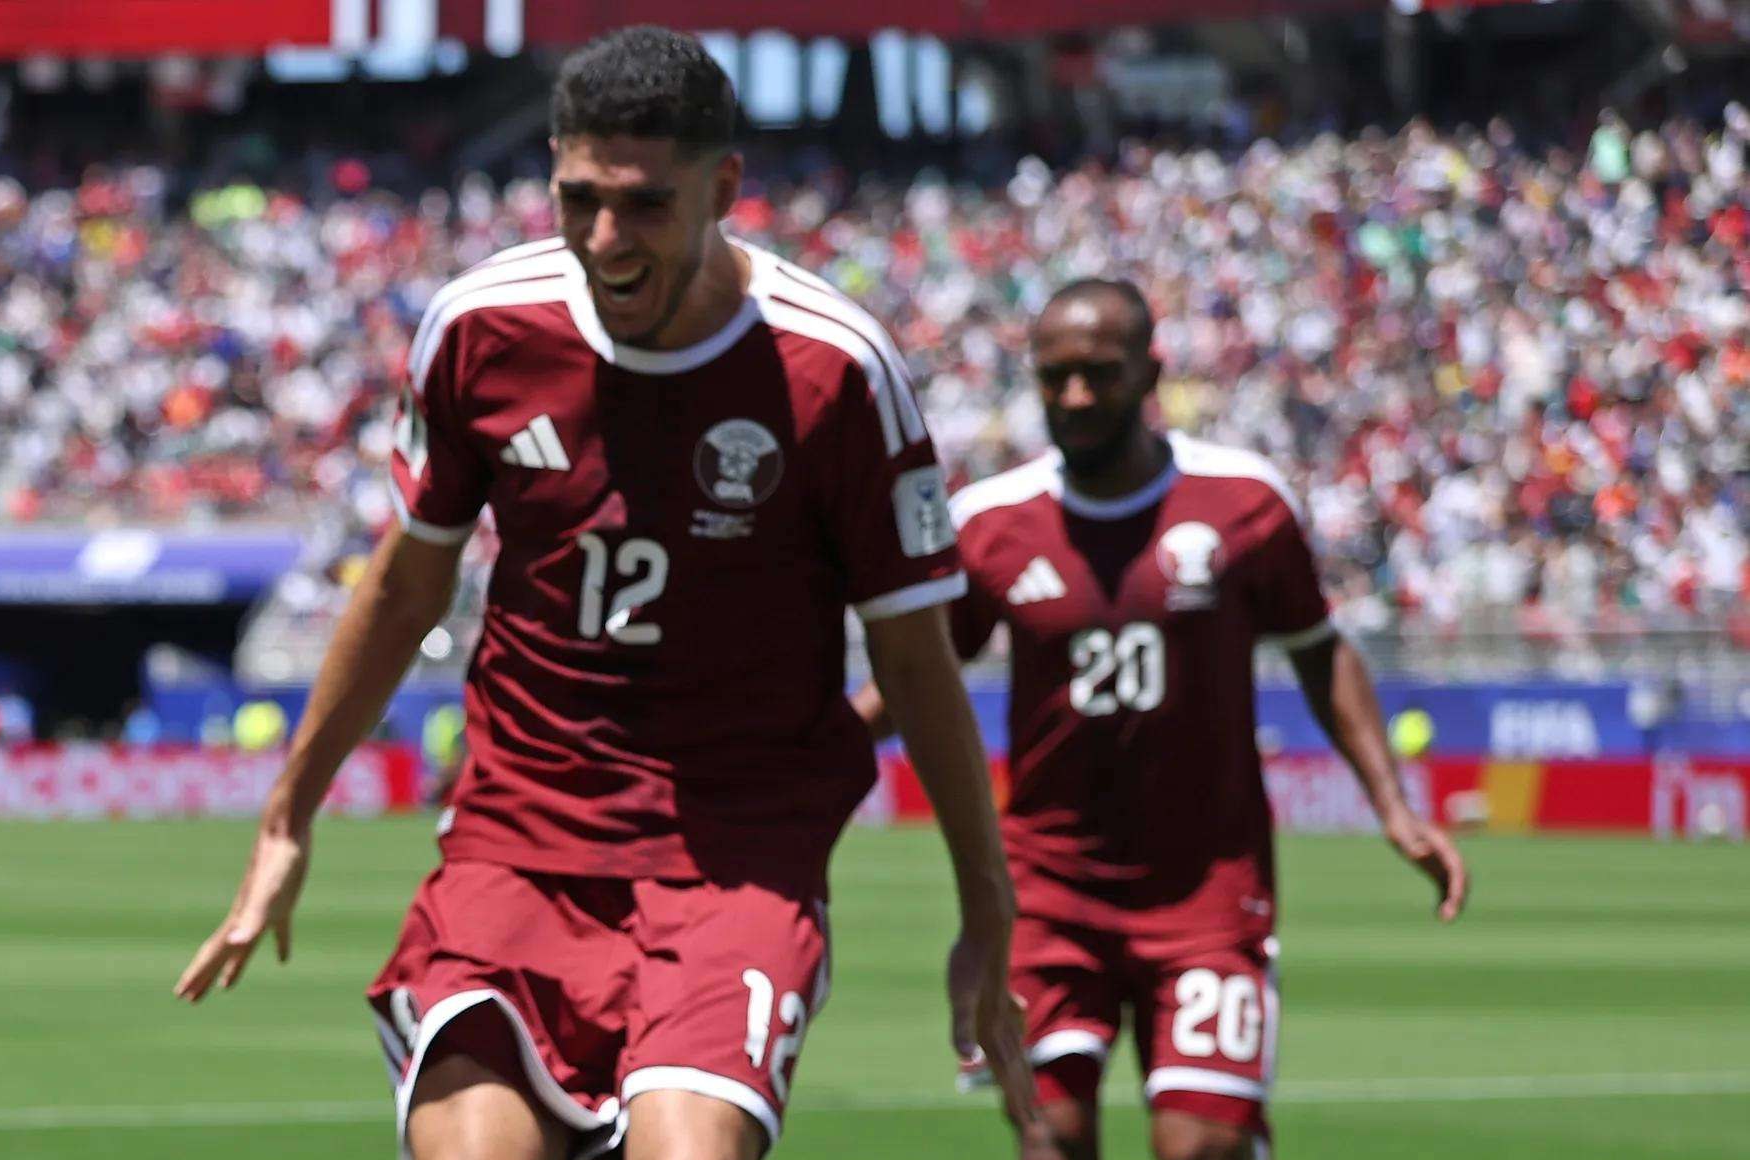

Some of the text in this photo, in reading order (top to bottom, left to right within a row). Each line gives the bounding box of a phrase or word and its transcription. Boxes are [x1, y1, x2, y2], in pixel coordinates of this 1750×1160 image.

[576, 531, 670, 645] 12
[1069, 621, 1166, 718] 20
[742, 968, 807, 1101] 12
[1171, 967, 1264, 1063] 20
